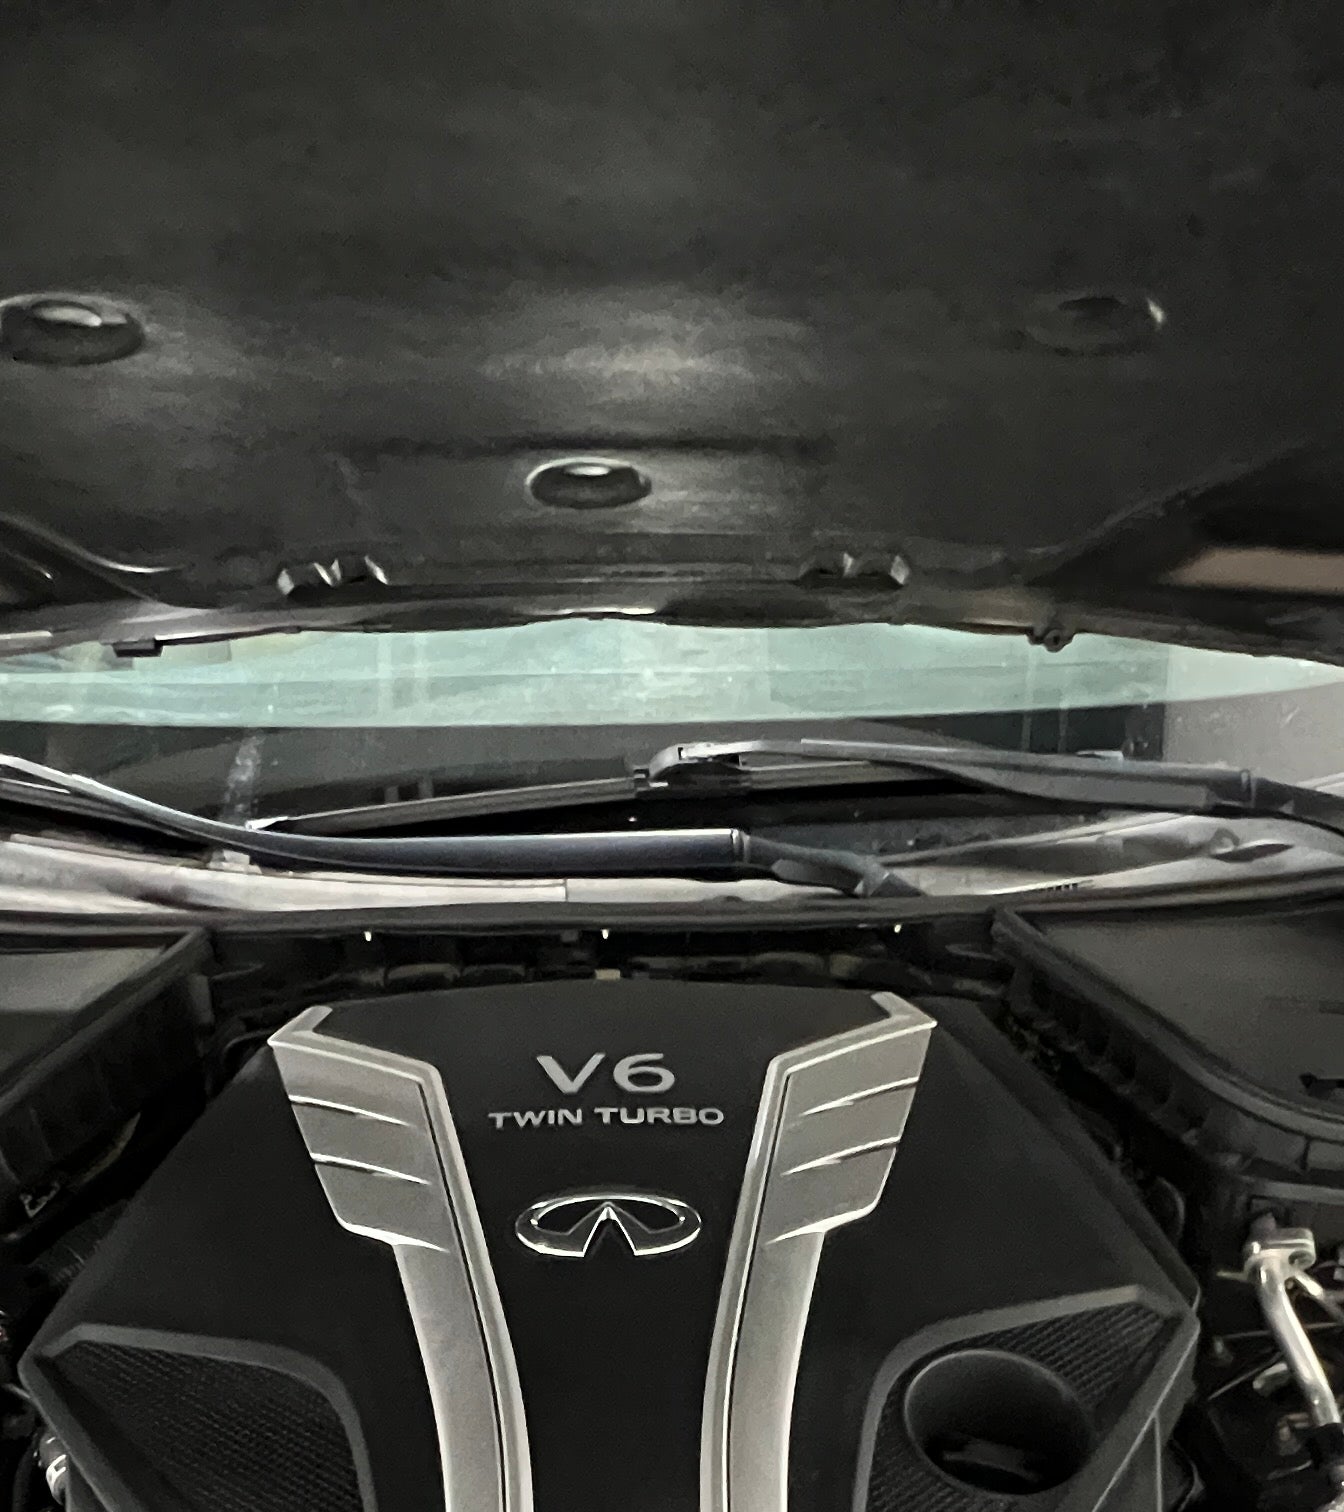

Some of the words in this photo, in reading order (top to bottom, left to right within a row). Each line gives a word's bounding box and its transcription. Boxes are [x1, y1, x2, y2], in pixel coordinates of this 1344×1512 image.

[536, 1052, 676, 1094] V6
[487, 1108, 583, 1130] TWIN
[593, 1106, 725, 1125] TURBO
